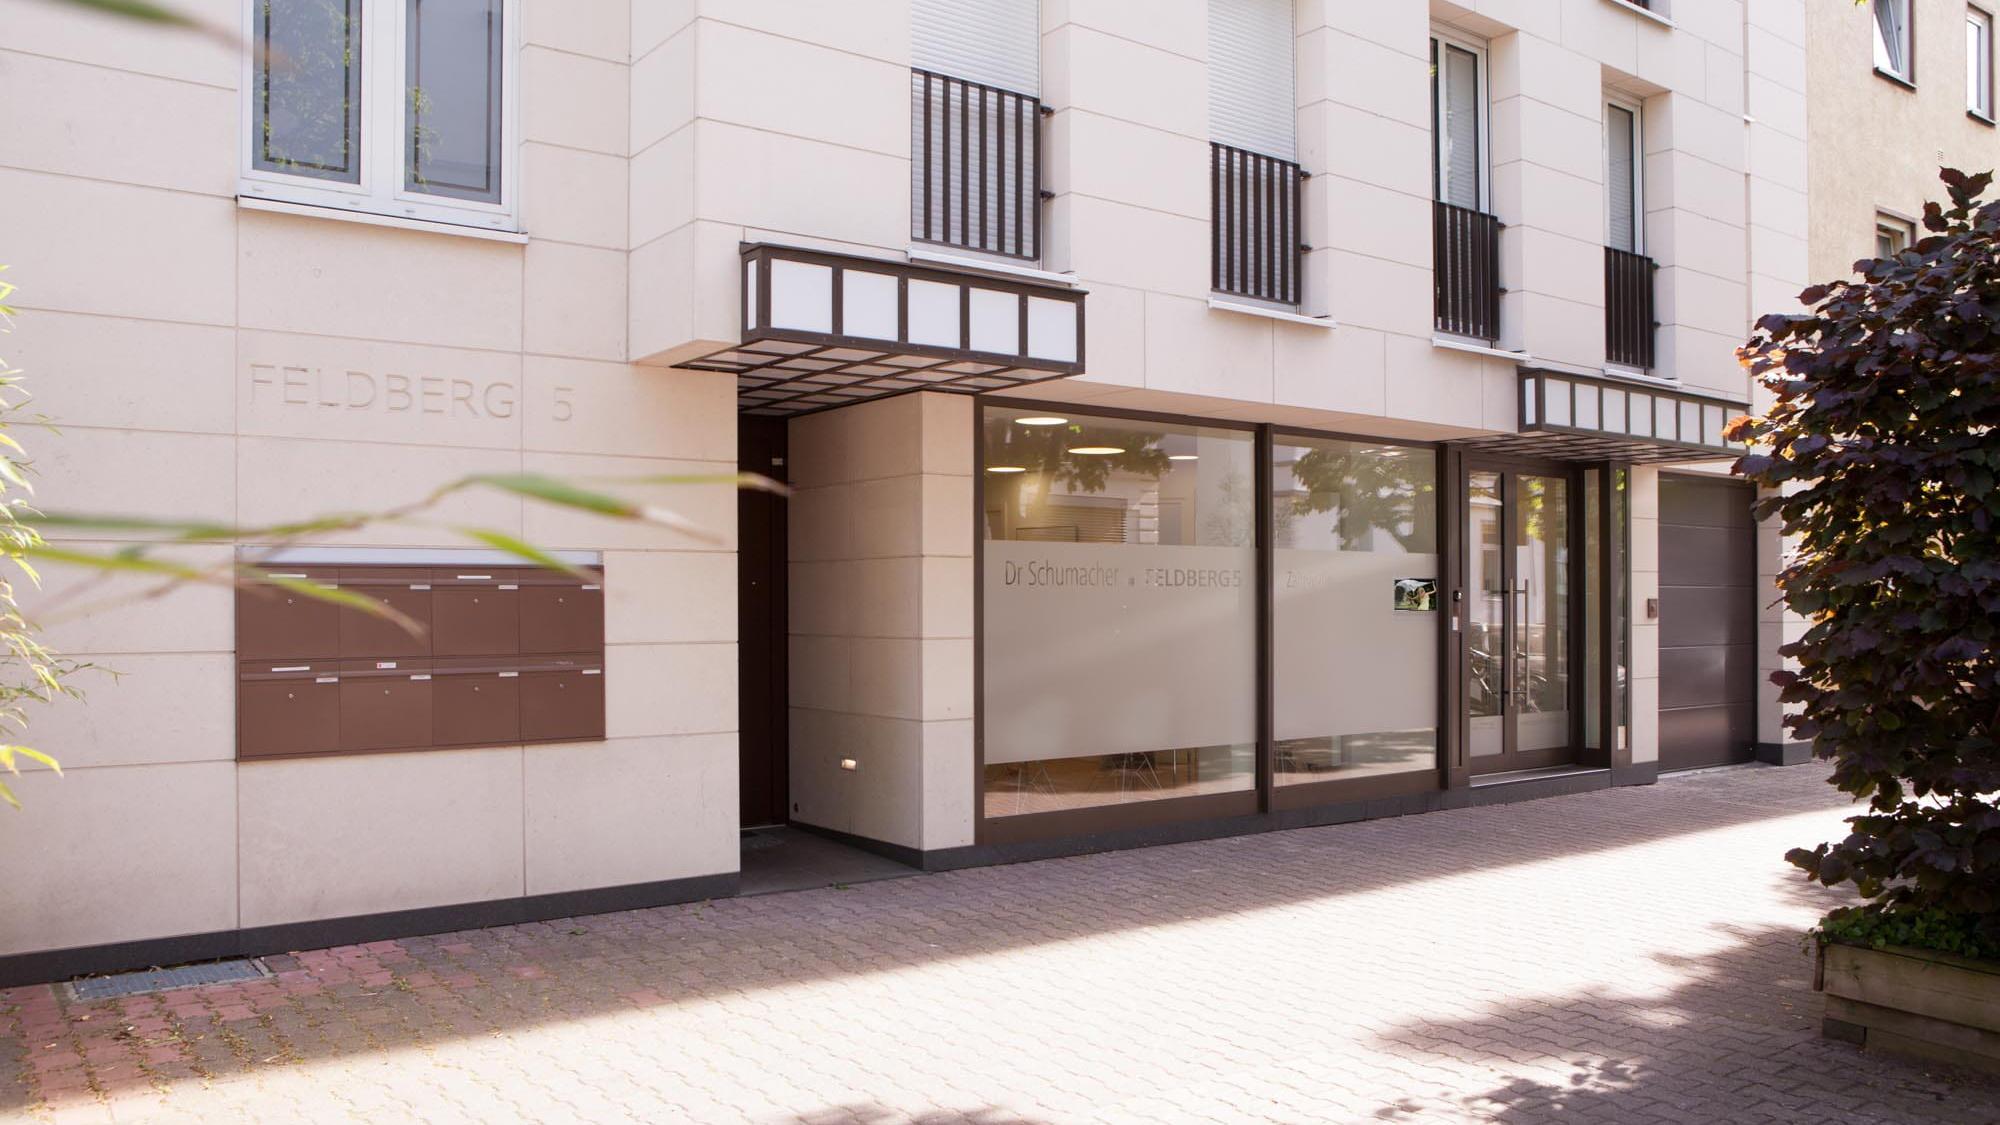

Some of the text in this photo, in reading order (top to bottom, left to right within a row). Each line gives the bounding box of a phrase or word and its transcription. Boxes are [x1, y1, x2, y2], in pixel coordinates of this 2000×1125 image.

[250, 364, 574, 422] FELDBERG 5
[1005, 560, 1022, 586] Dr
[1028, 560, 1119, 587] Schumacher
